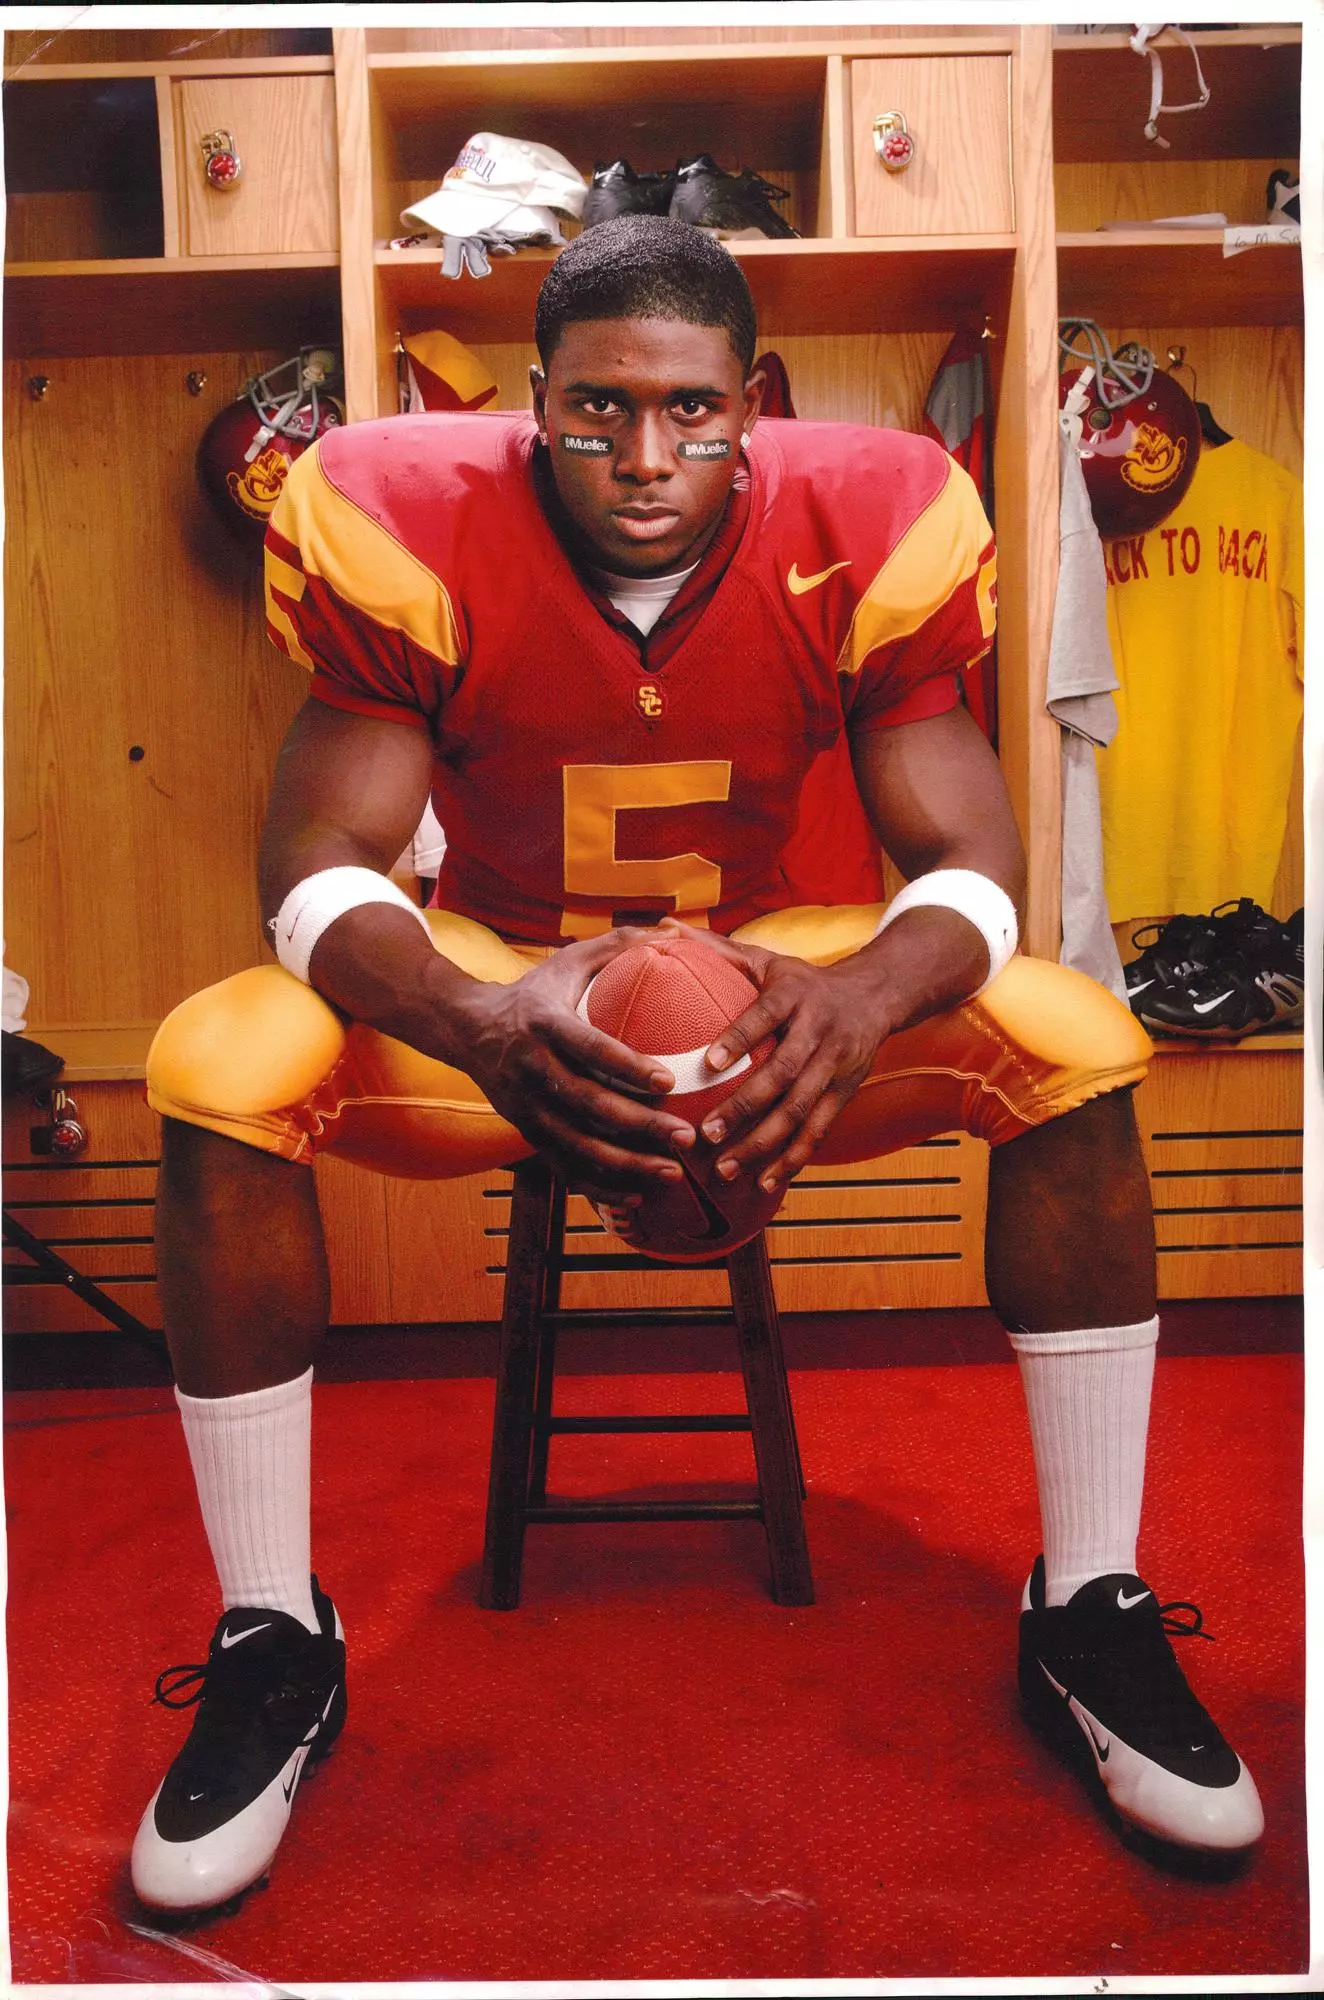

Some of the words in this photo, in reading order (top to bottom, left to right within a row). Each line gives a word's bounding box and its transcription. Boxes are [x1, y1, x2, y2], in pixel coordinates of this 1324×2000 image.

[1160, 526, 1200, 577] TO
[639, 686, 663, 717] SC
[560, 760, 732, 940] 5
